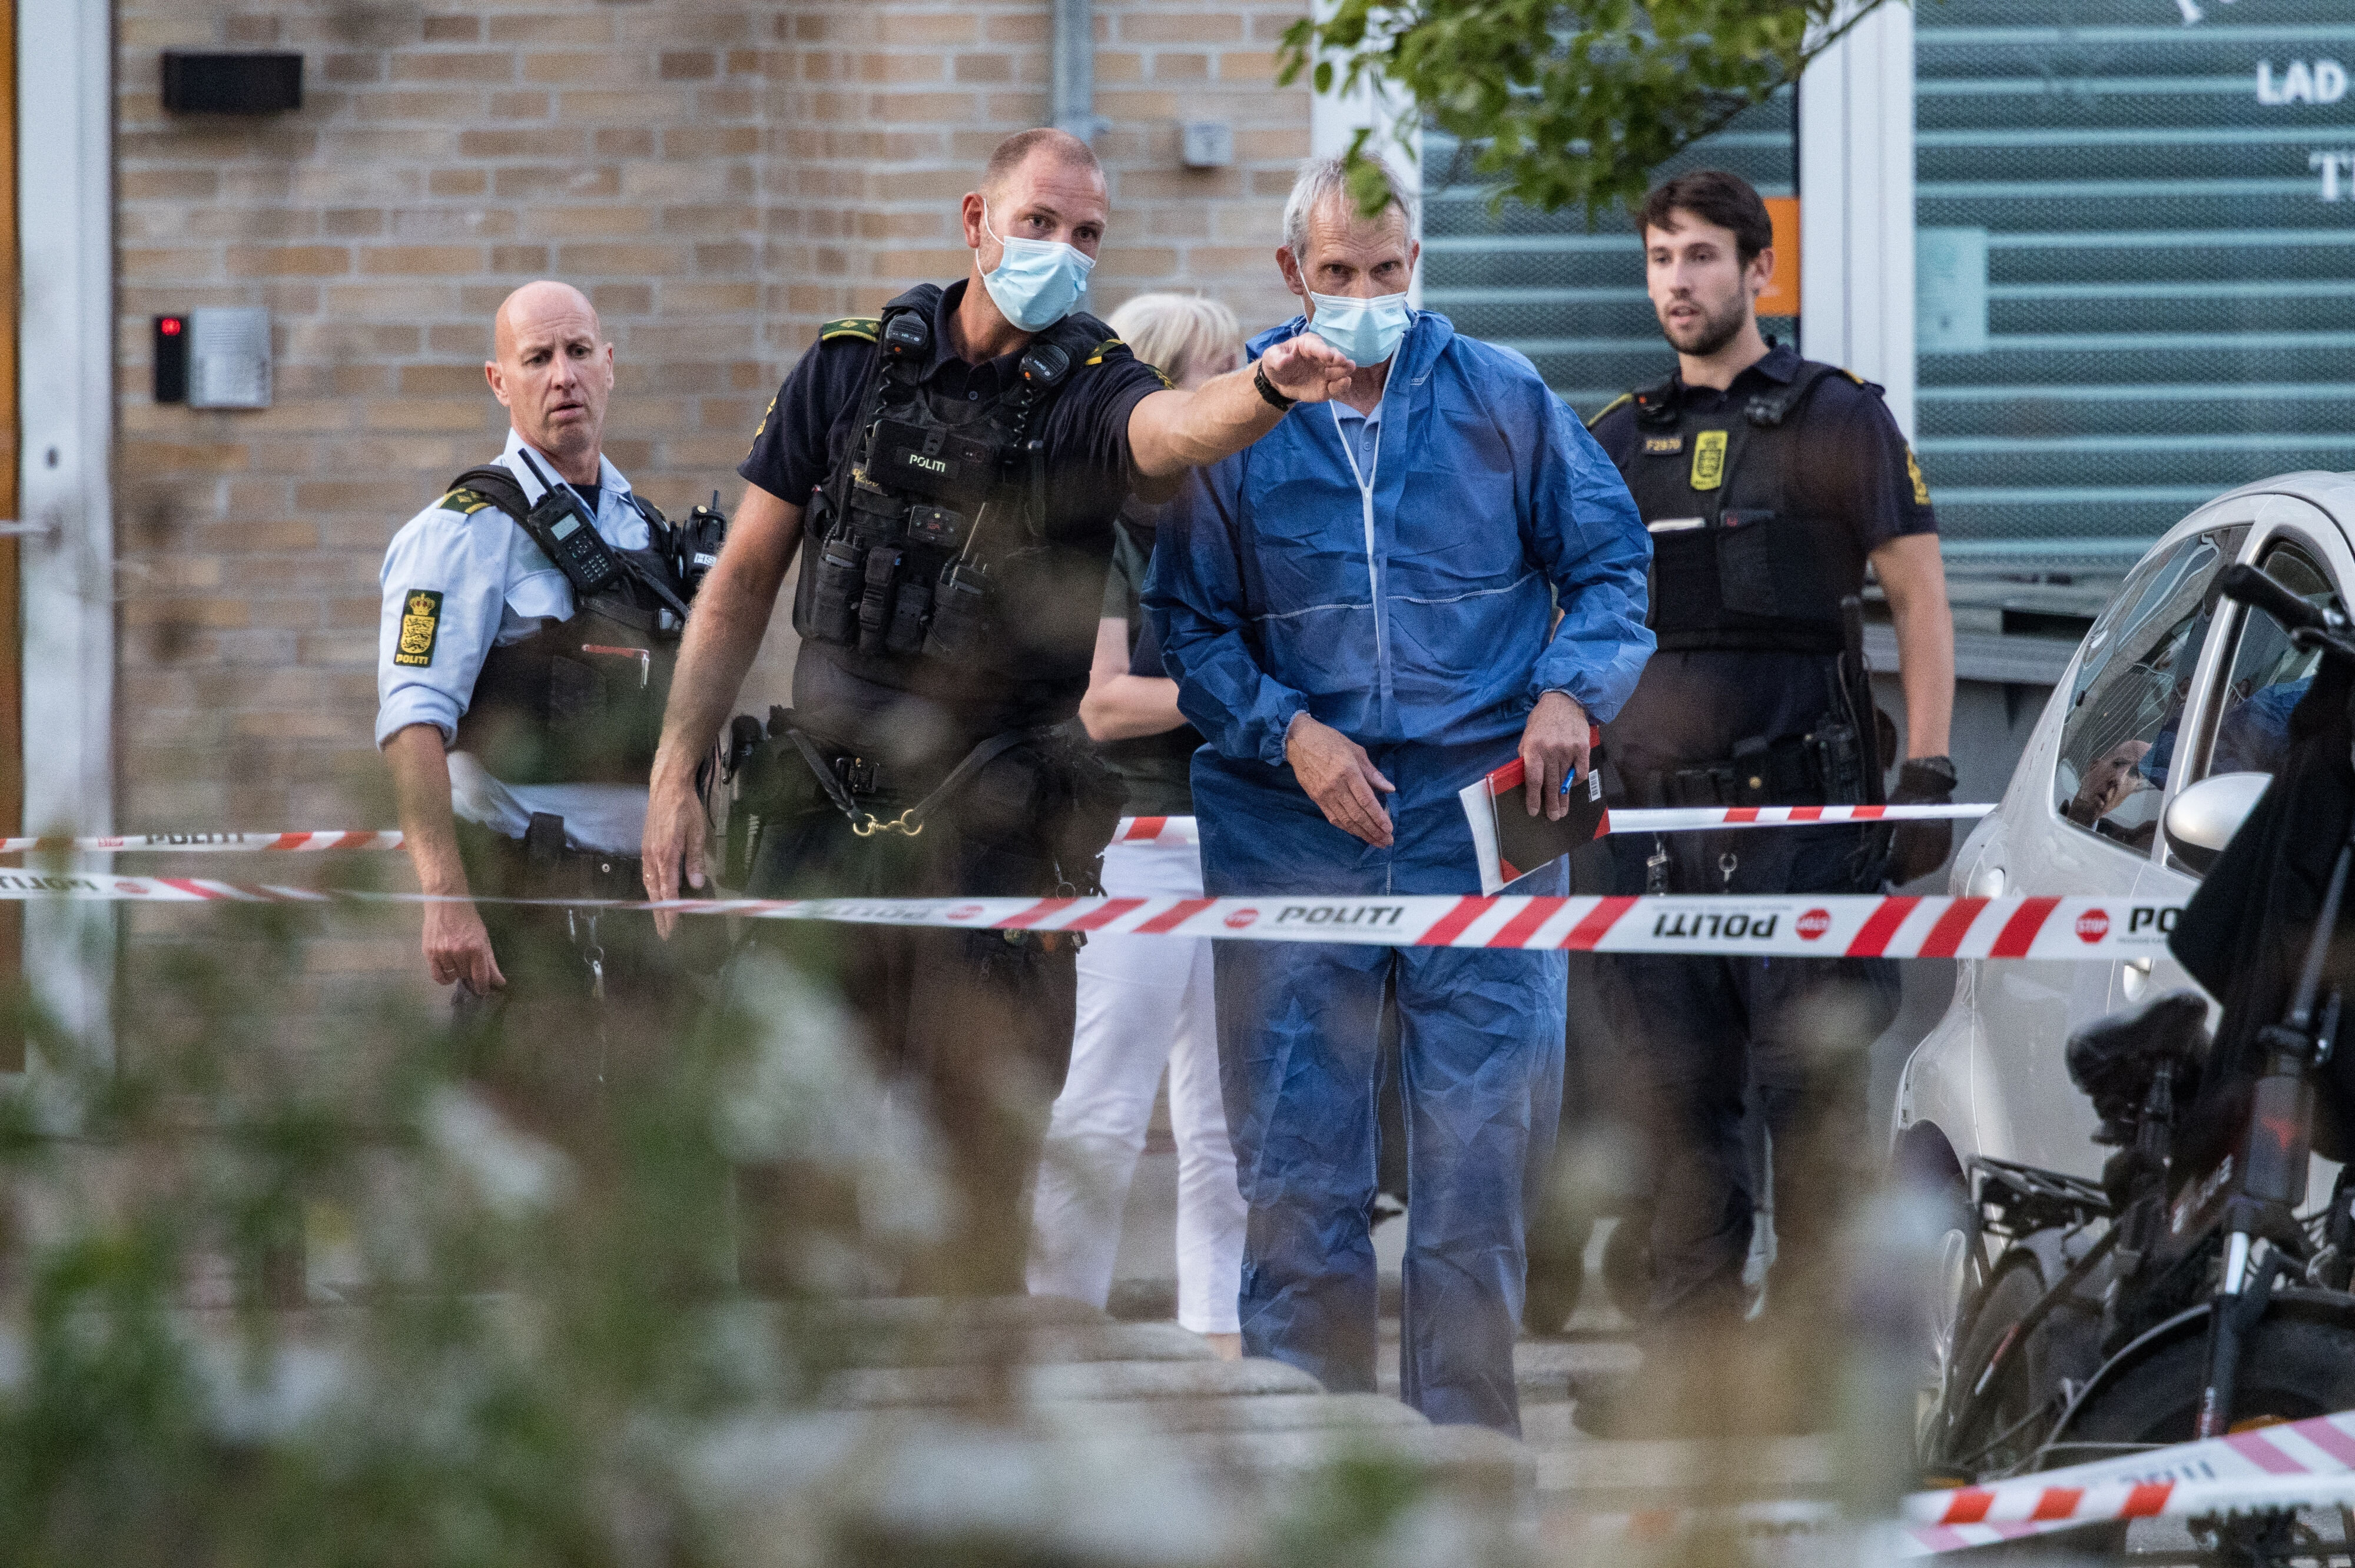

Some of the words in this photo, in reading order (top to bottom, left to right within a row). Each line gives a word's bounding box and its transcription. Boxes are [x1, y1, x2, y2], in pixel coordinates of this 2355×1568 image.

[2257, 59, 2347, 105] LAD
[909, 454, 946, 473] POLITI
[395, 653, 429, 665] POLITI
[1276, 906, 1405, 925] POLITI
[1653, 913, 1780, 939] POLITI
